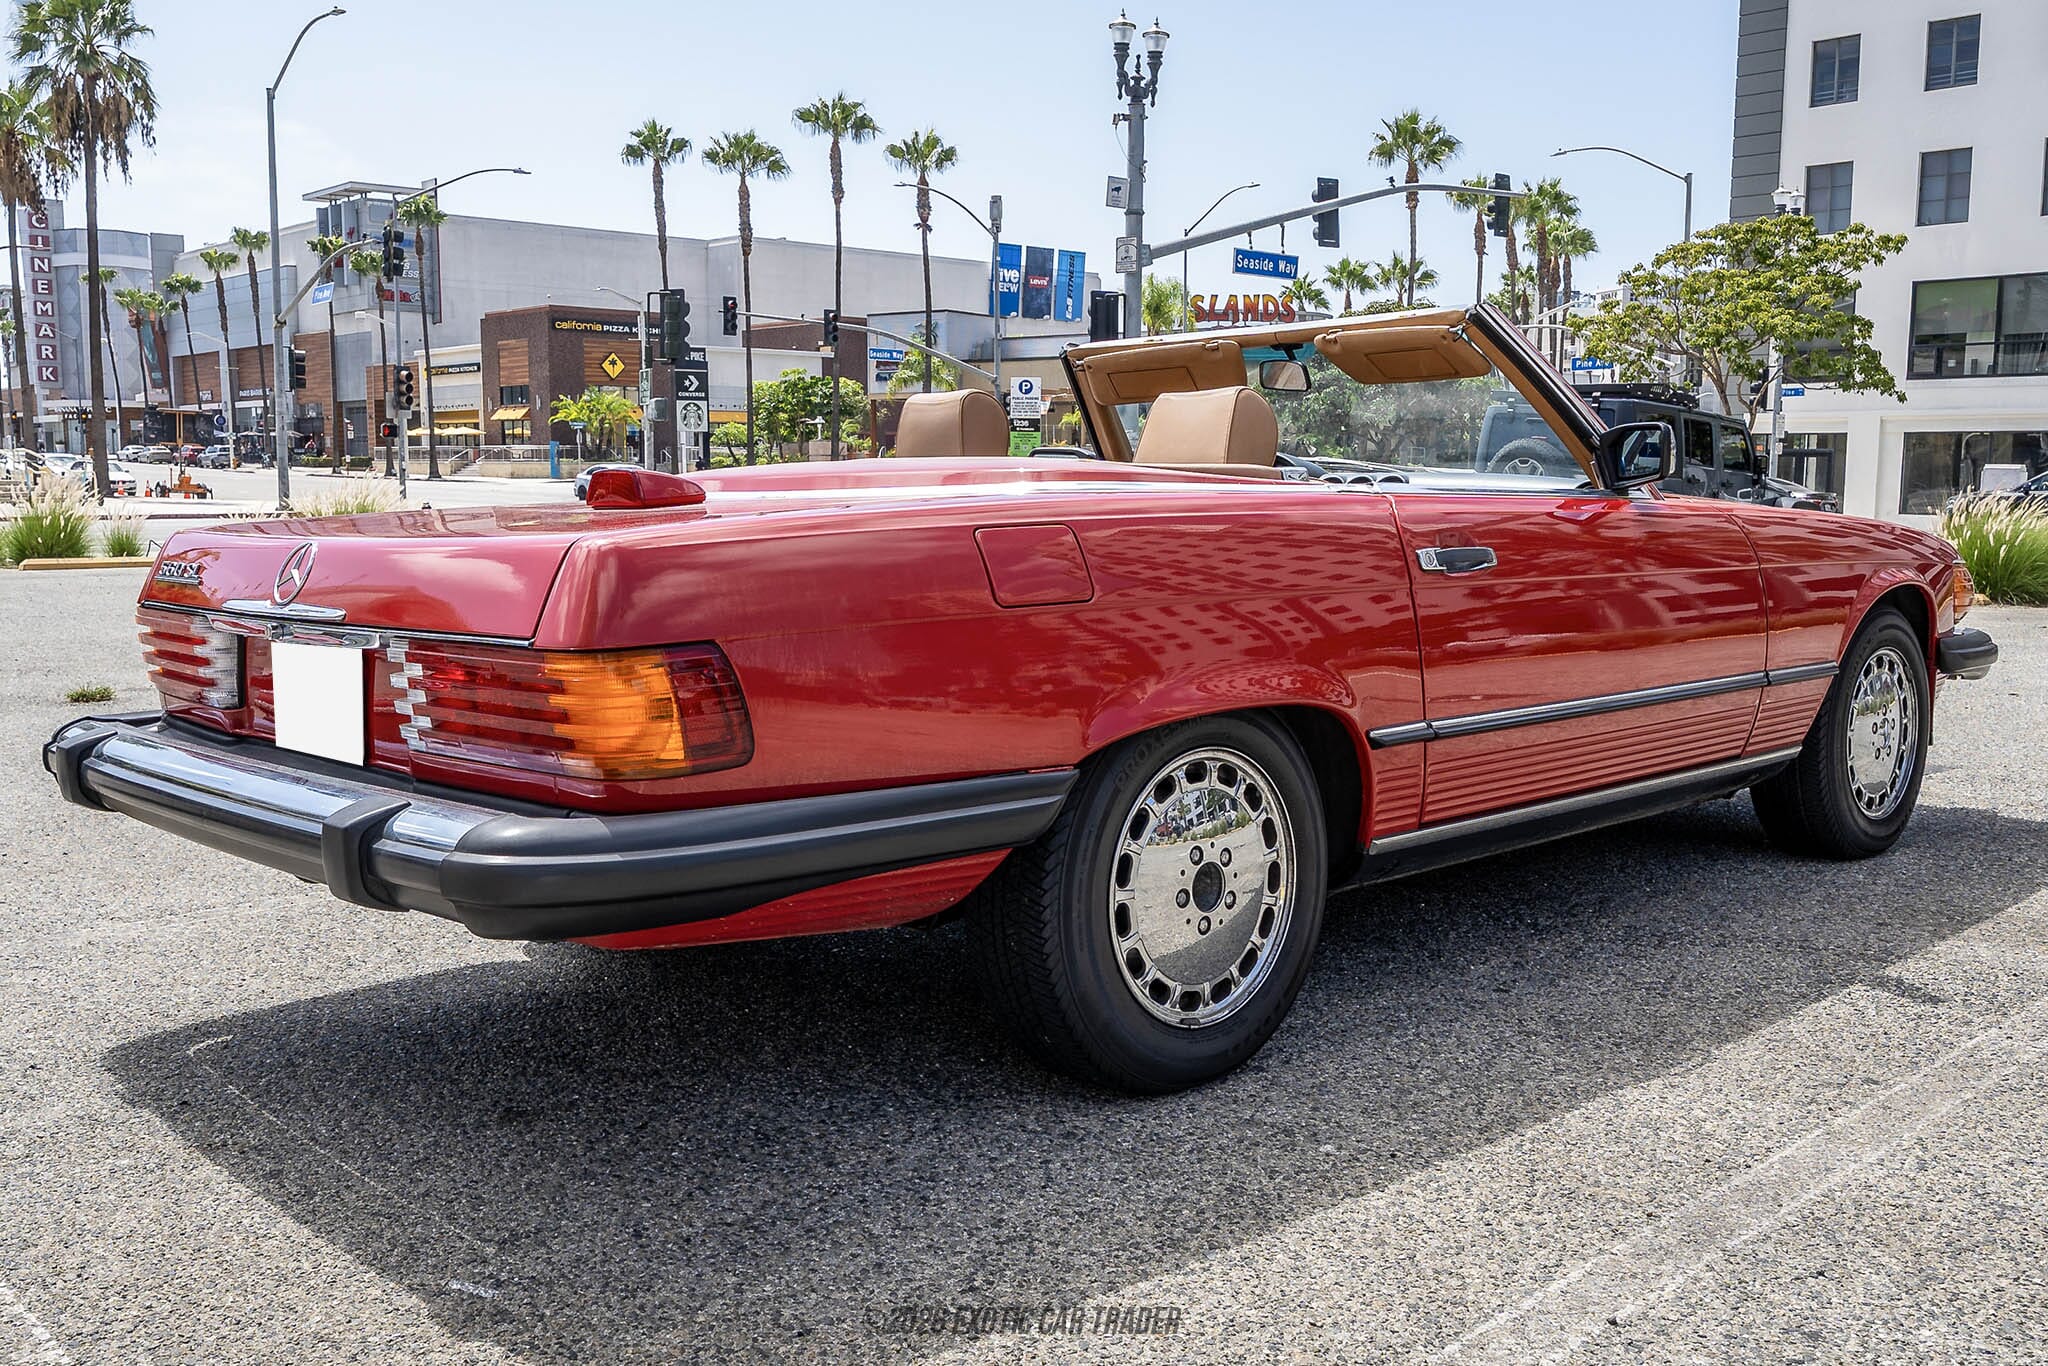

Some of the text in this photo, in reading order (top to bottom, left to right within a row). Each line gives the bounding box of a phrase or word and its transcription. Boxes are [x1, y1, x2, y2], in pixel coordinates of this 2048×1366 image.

[1236, 254, 1297, 276] Seaside Way
[997, 267, 1020, 284] ive
[1066, 254, 1076, 299] FITNESS
[31, 212, 58, 382] CINEMARK
[555, 320, 603, 332] california
[603, 324, 630, 333] PIZZA
[870, 350, 891, 358] Seaside
[1576, 360, 1593, 368] Pine
[159, 560, 200, 578] 560 SL
